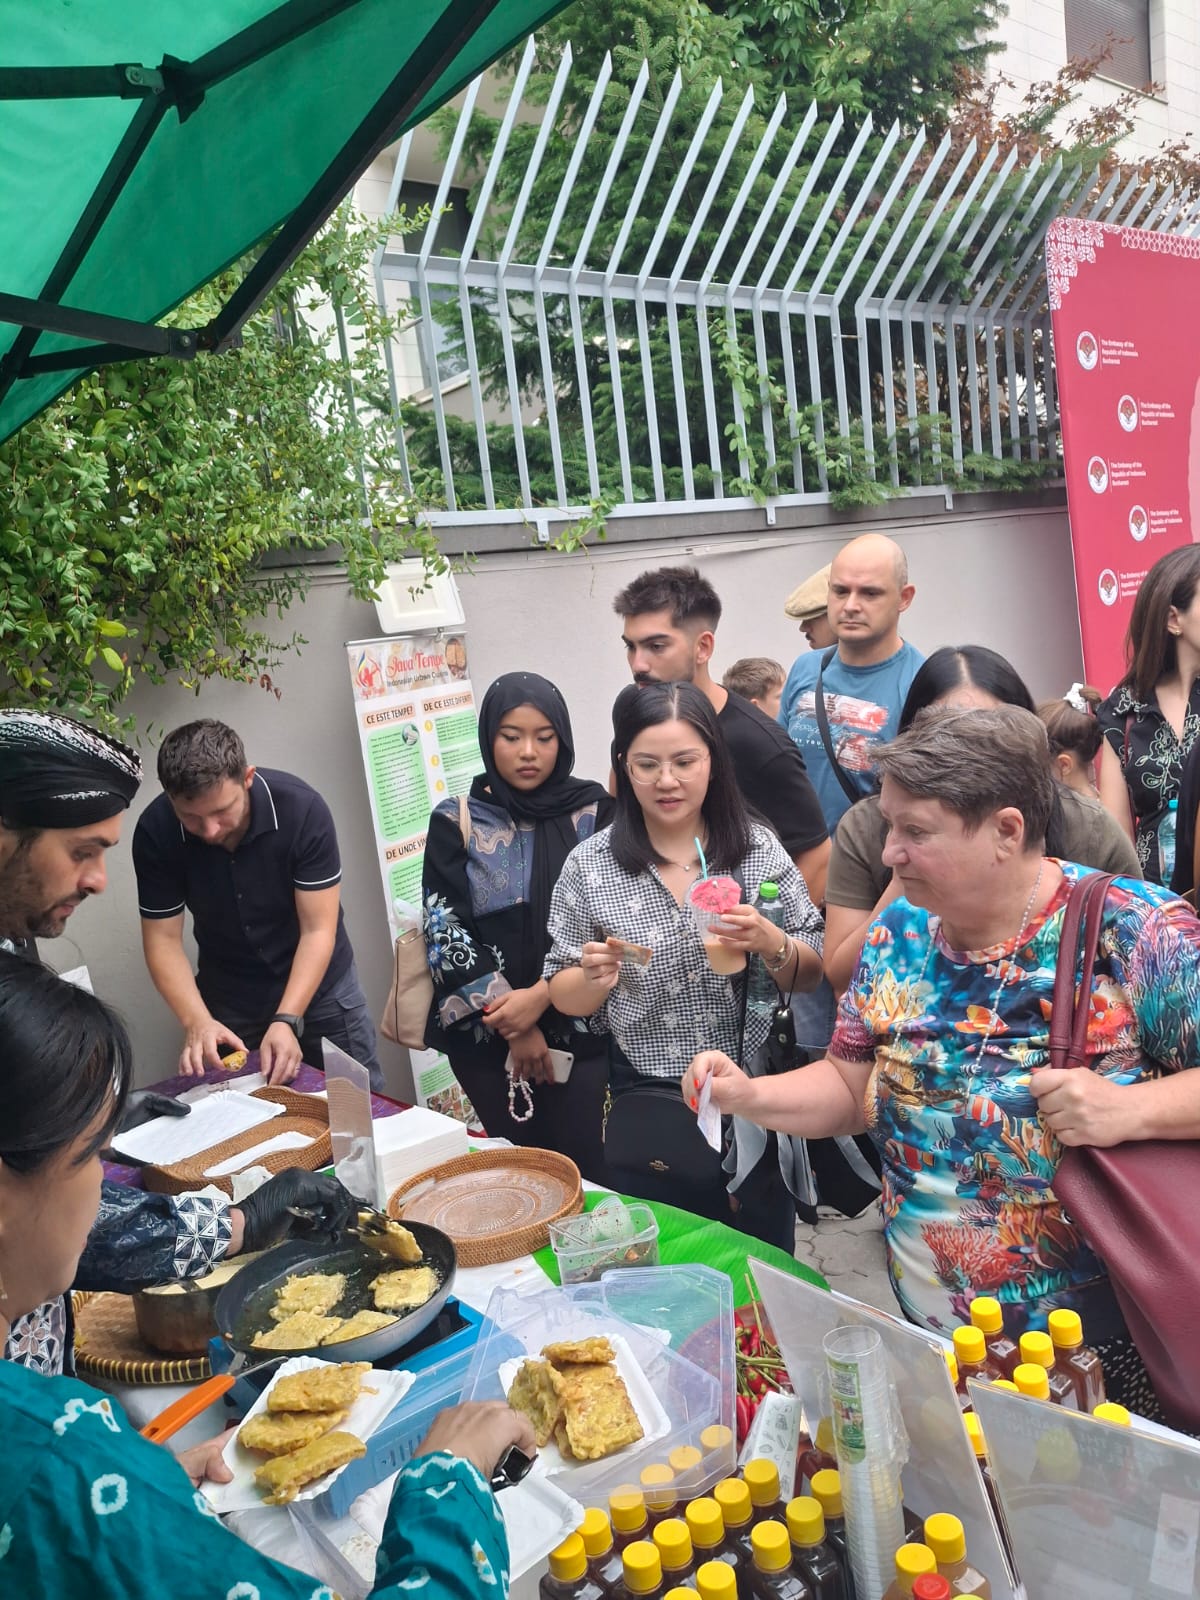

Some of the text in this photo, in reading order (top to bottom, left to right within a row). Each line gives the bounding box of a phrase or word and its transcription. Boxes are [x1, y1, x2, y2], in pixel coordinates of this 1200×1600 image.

[387, 651, 444, 678] Java Tempe
[413, 673, 431, 682] Urban
[423, 703, 433, 711] DE
[434, 700, 443, 709] CE
[443, 698, 455, 707] ESTE
[366, 705, 413, 724] CE ESTE TEMPE?
[385, 849, 397, 860] DE
[398, 841, 417, 856] UNDE
